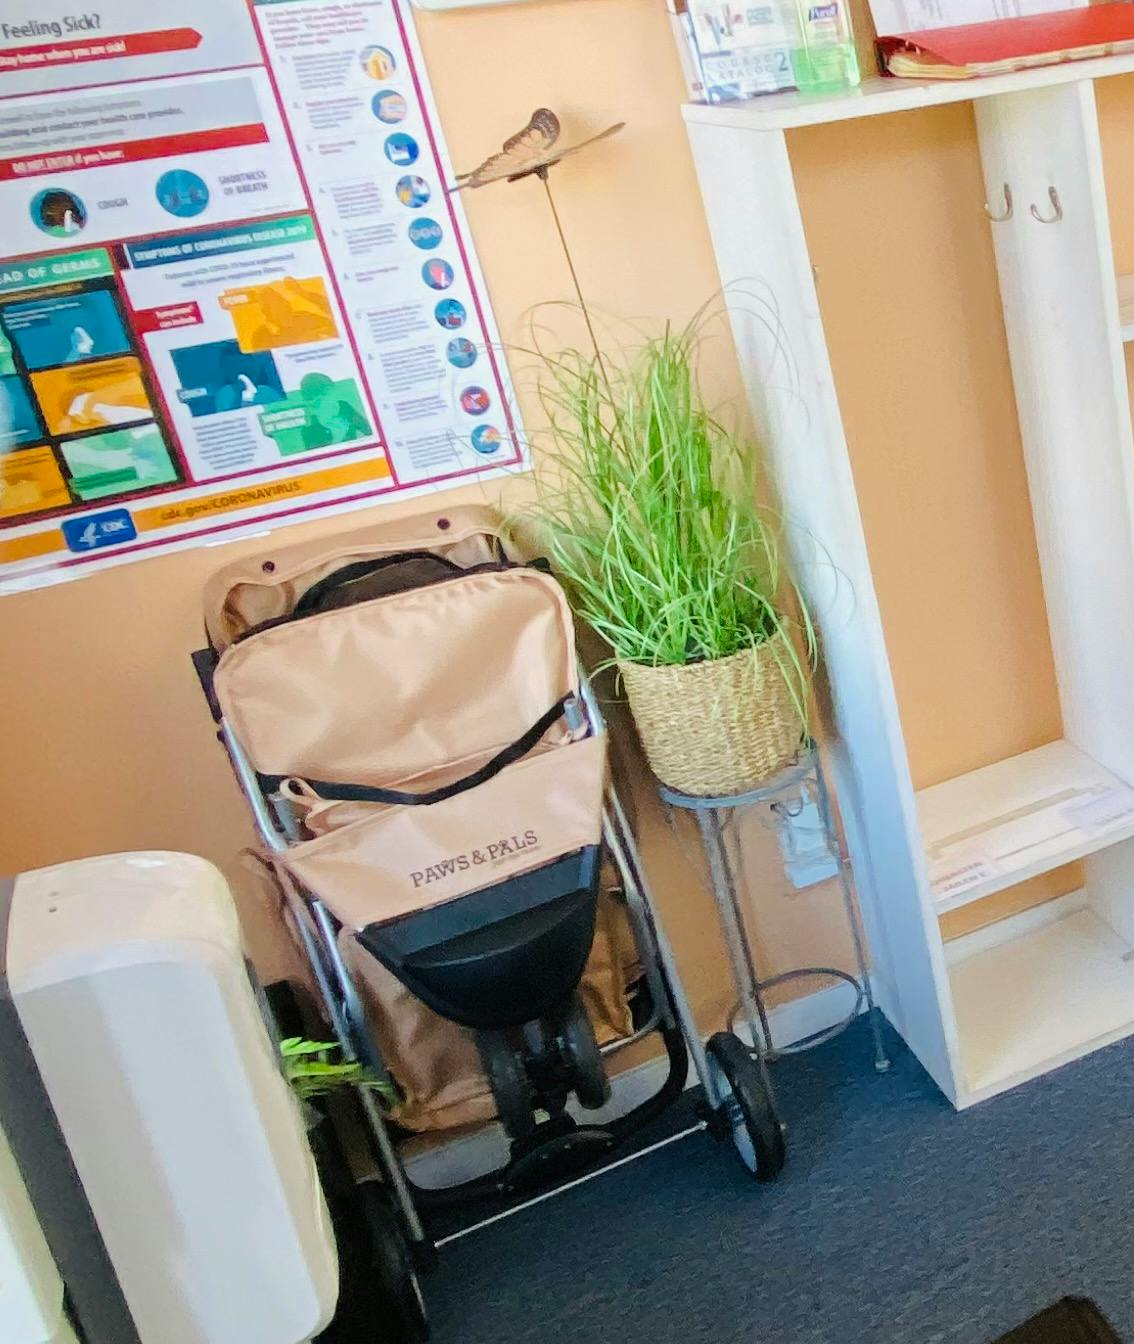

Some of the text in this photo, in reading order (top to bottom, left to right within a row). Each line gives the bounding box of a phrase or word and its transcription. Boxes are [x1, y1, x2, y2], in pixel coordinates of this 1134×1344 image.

[1, 13, 102, 40] Feeling Sick?
[27, 266, 48, 279] OF
[50, 258, 102, 275] GERMS
